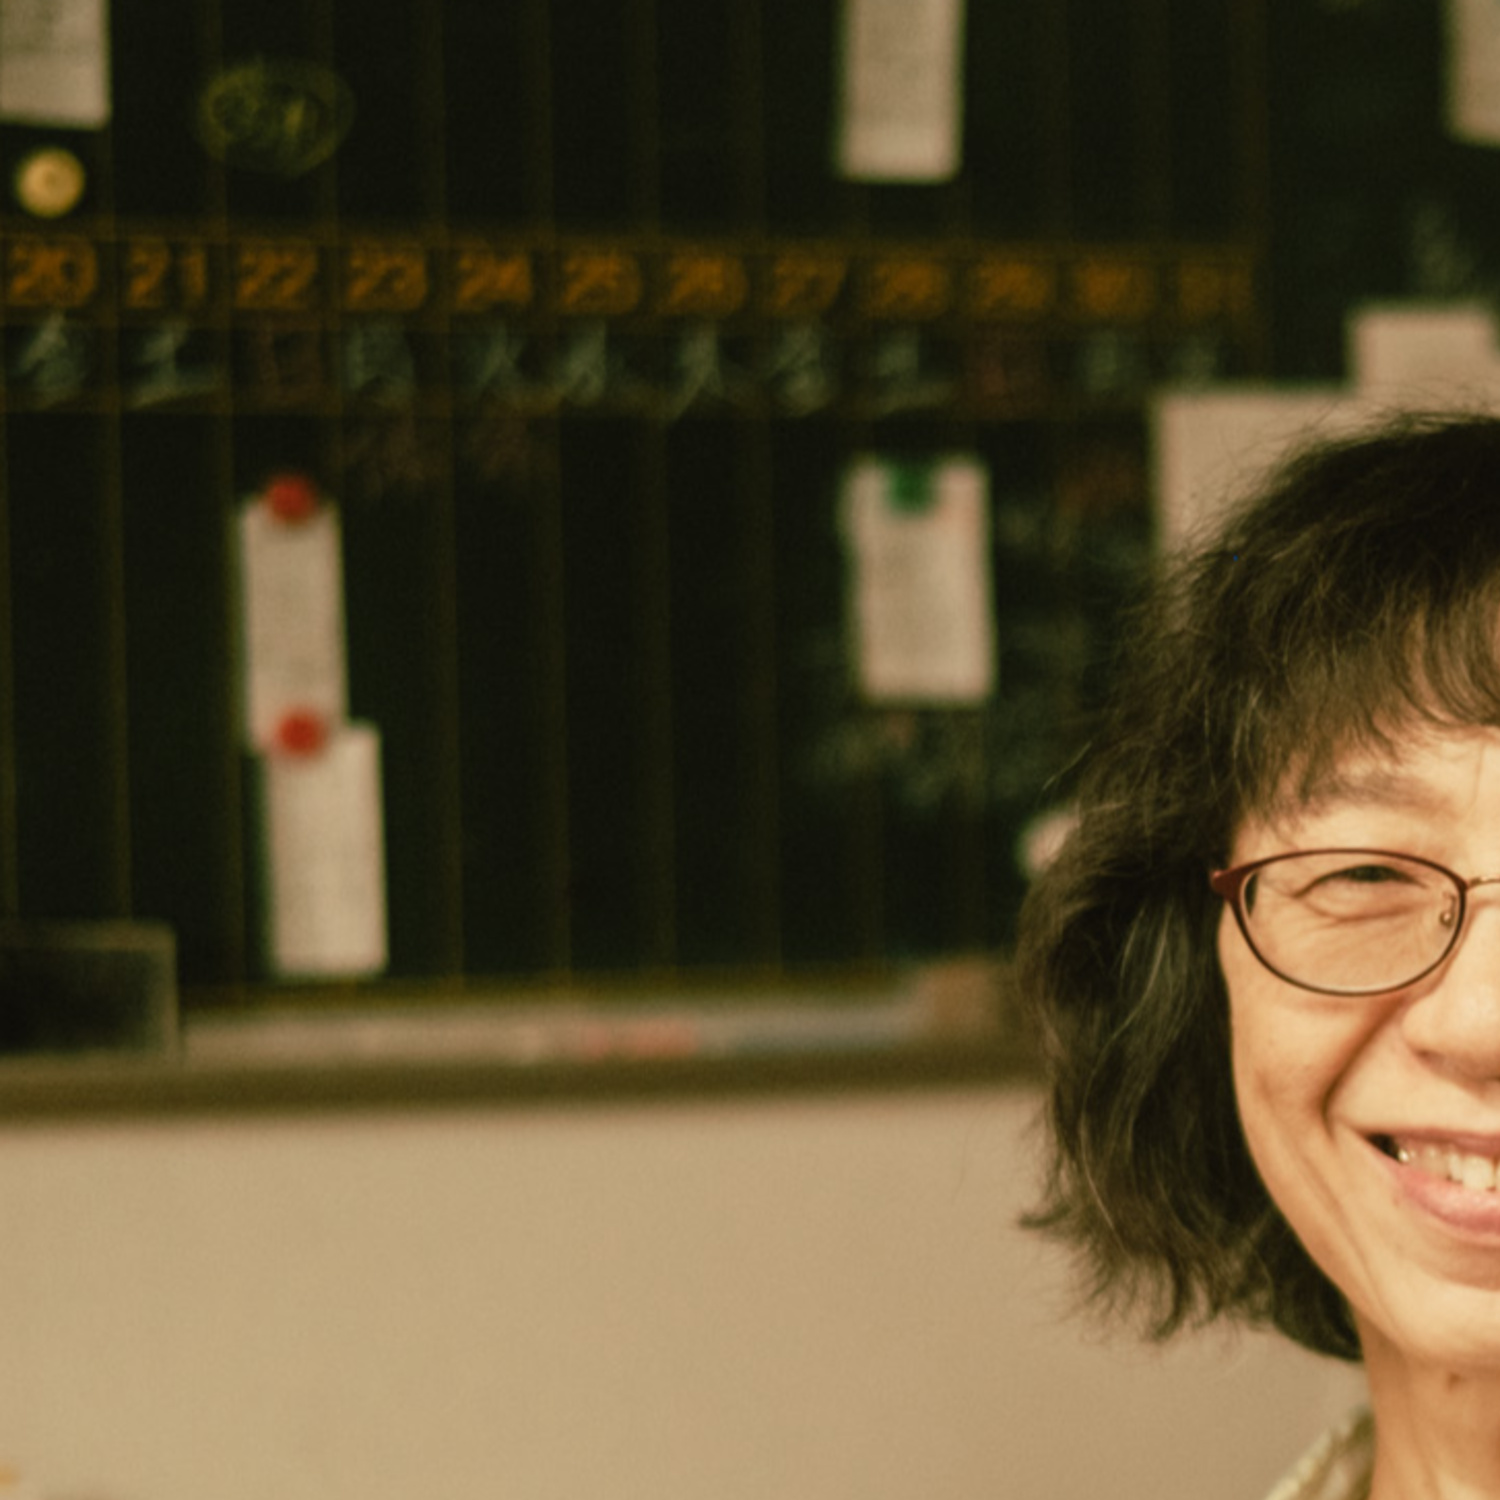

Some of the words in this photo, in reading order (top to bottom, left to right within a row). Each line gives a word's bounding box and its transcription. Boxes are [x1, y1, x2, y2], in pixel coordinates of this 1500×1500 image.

[4, 241, 97, 308] 20
[126, 241, 208, 309] 21
[234, 243, 318, 310] 22
[344, 244, 428, 311] 23
[455, 246, 533, 312] 24
[561, 247, 642, 314] 25
